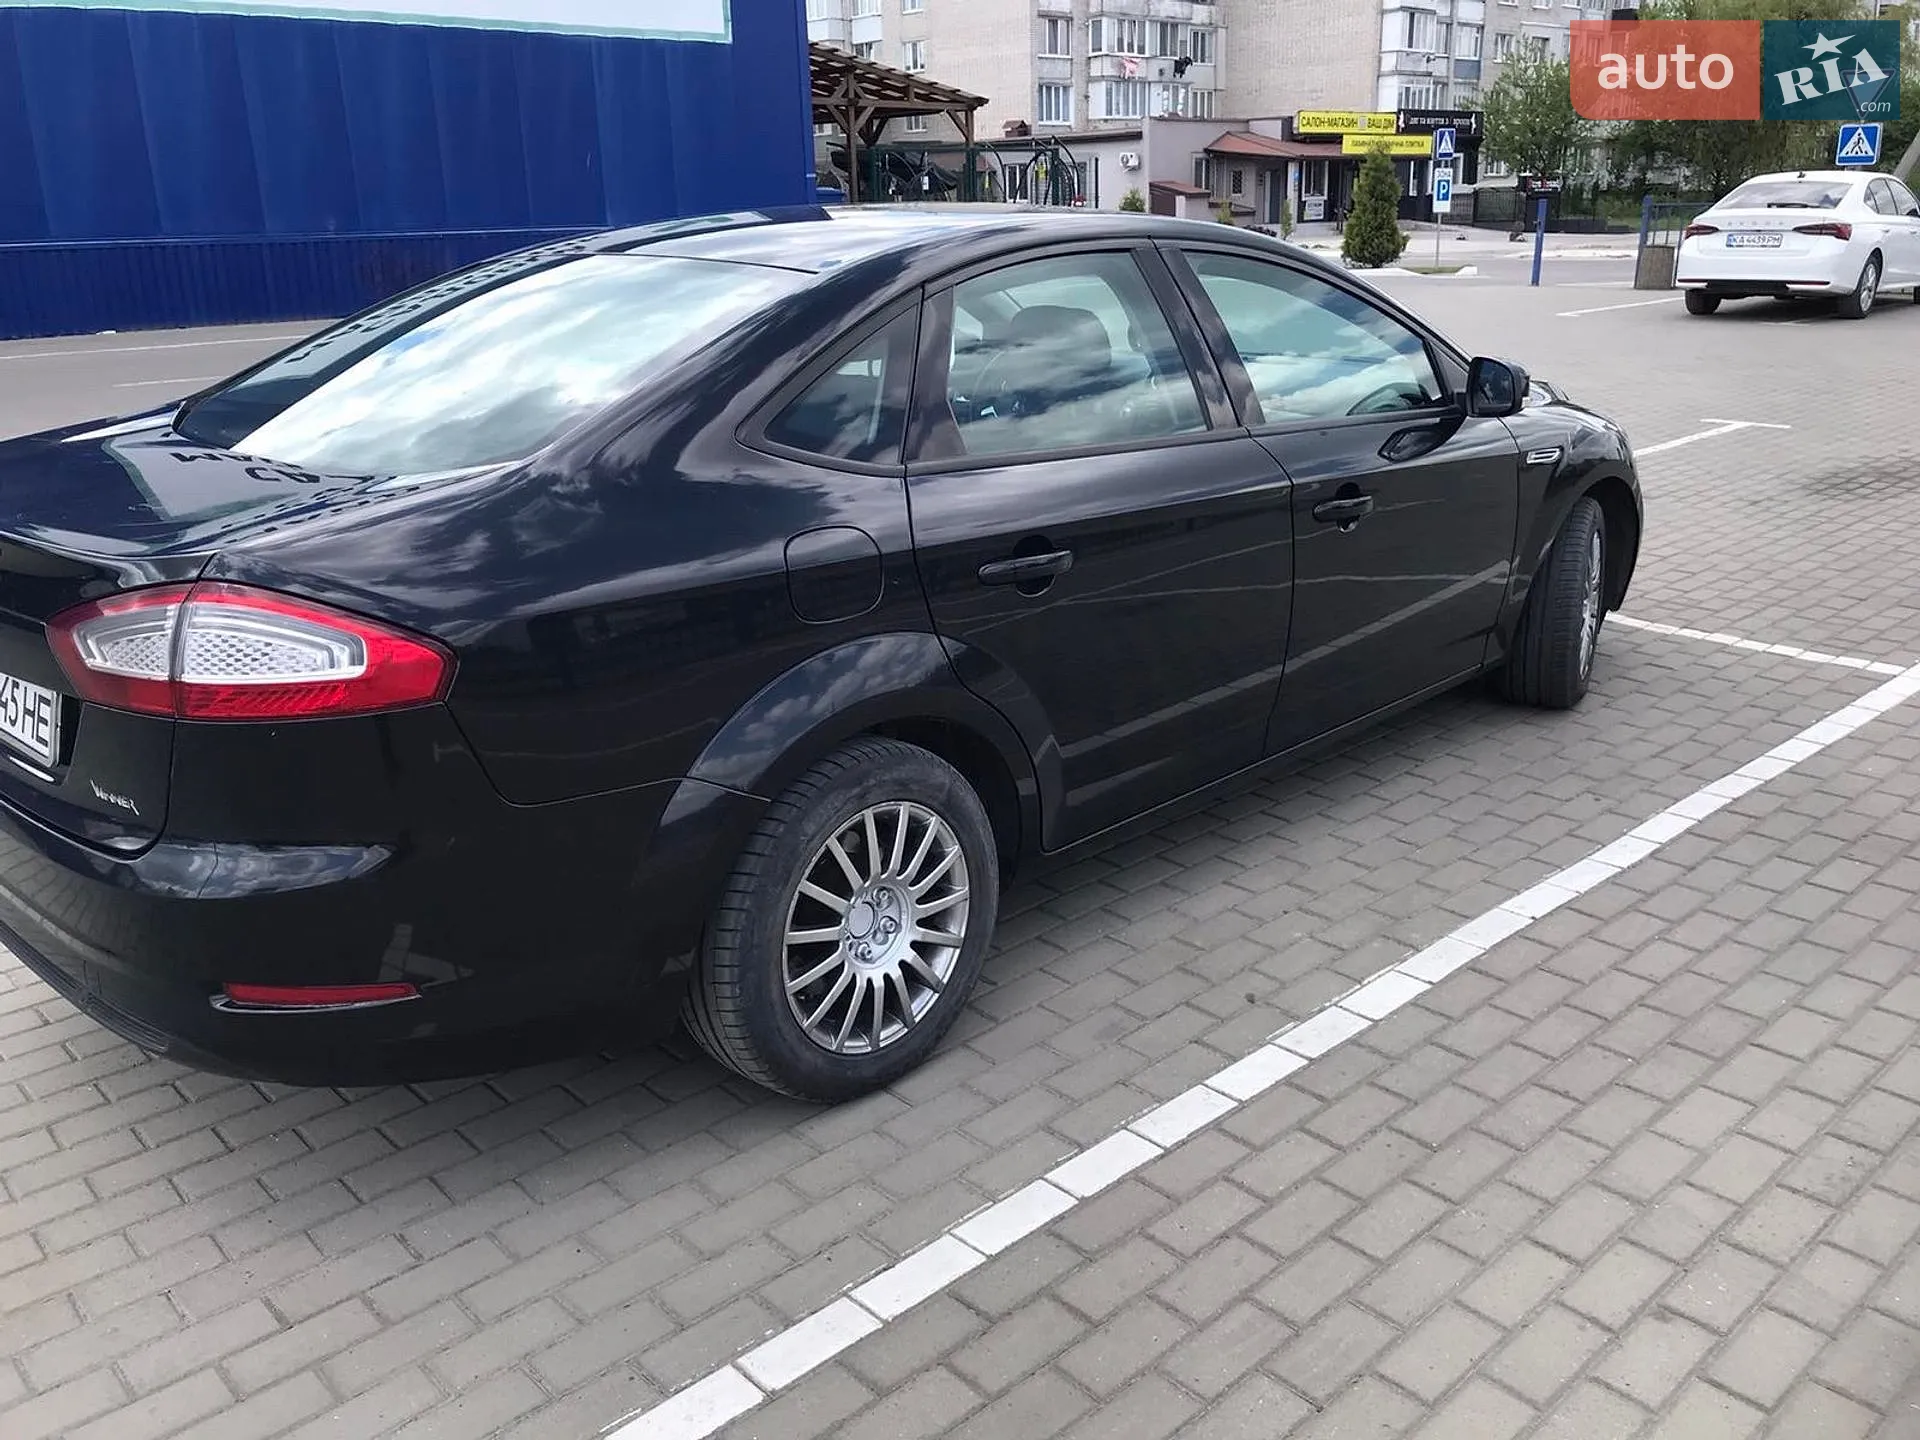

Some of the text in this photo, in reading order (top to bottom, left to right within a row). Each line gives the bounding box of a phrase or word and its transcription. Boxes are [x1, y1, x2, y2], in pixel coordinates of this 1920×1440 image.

[1301, 116, 1358, 127] САЛОН-МАГАЗИН
[1367, 117, 1382, 128] ВАШ
[21, 685, 51, 748] HE
